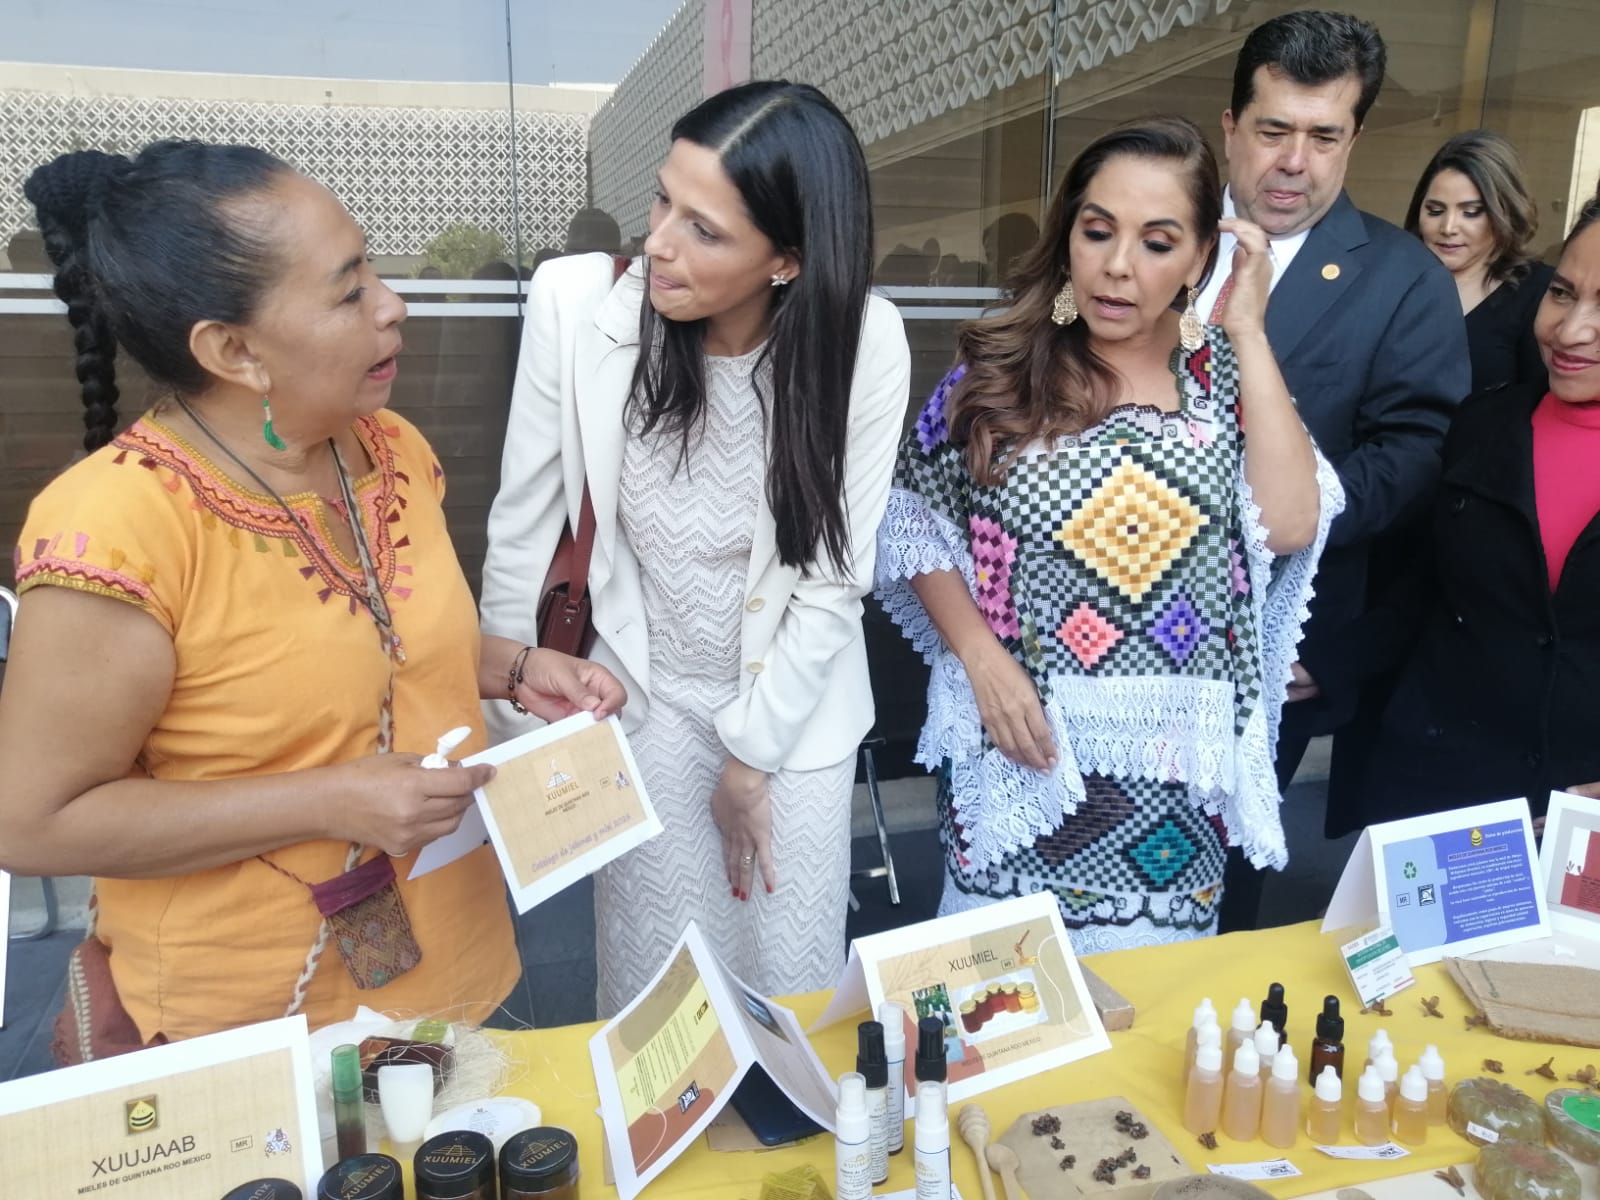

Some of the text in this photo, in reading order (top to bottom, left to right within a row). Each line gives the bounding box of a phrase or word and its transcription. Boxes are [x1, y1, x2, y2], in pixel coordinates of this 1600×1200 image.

[546, 782, 579, 801] XUUMIEL
[948, 949, 998, 973] XUUMIEL
[92, 1135, 196, 1177] XUUJAAB
[235, 1138, 248, 1149] MR
[520, 1140, 568, 1169] XUUMIEL
[423, 1155, 479, 1165] XUUMIEL
[77, 1153, 212, 1195] MIELES DE QUINTANA ROO MEXICO
[343, 1163, 391, 1200] XUUMIEL
